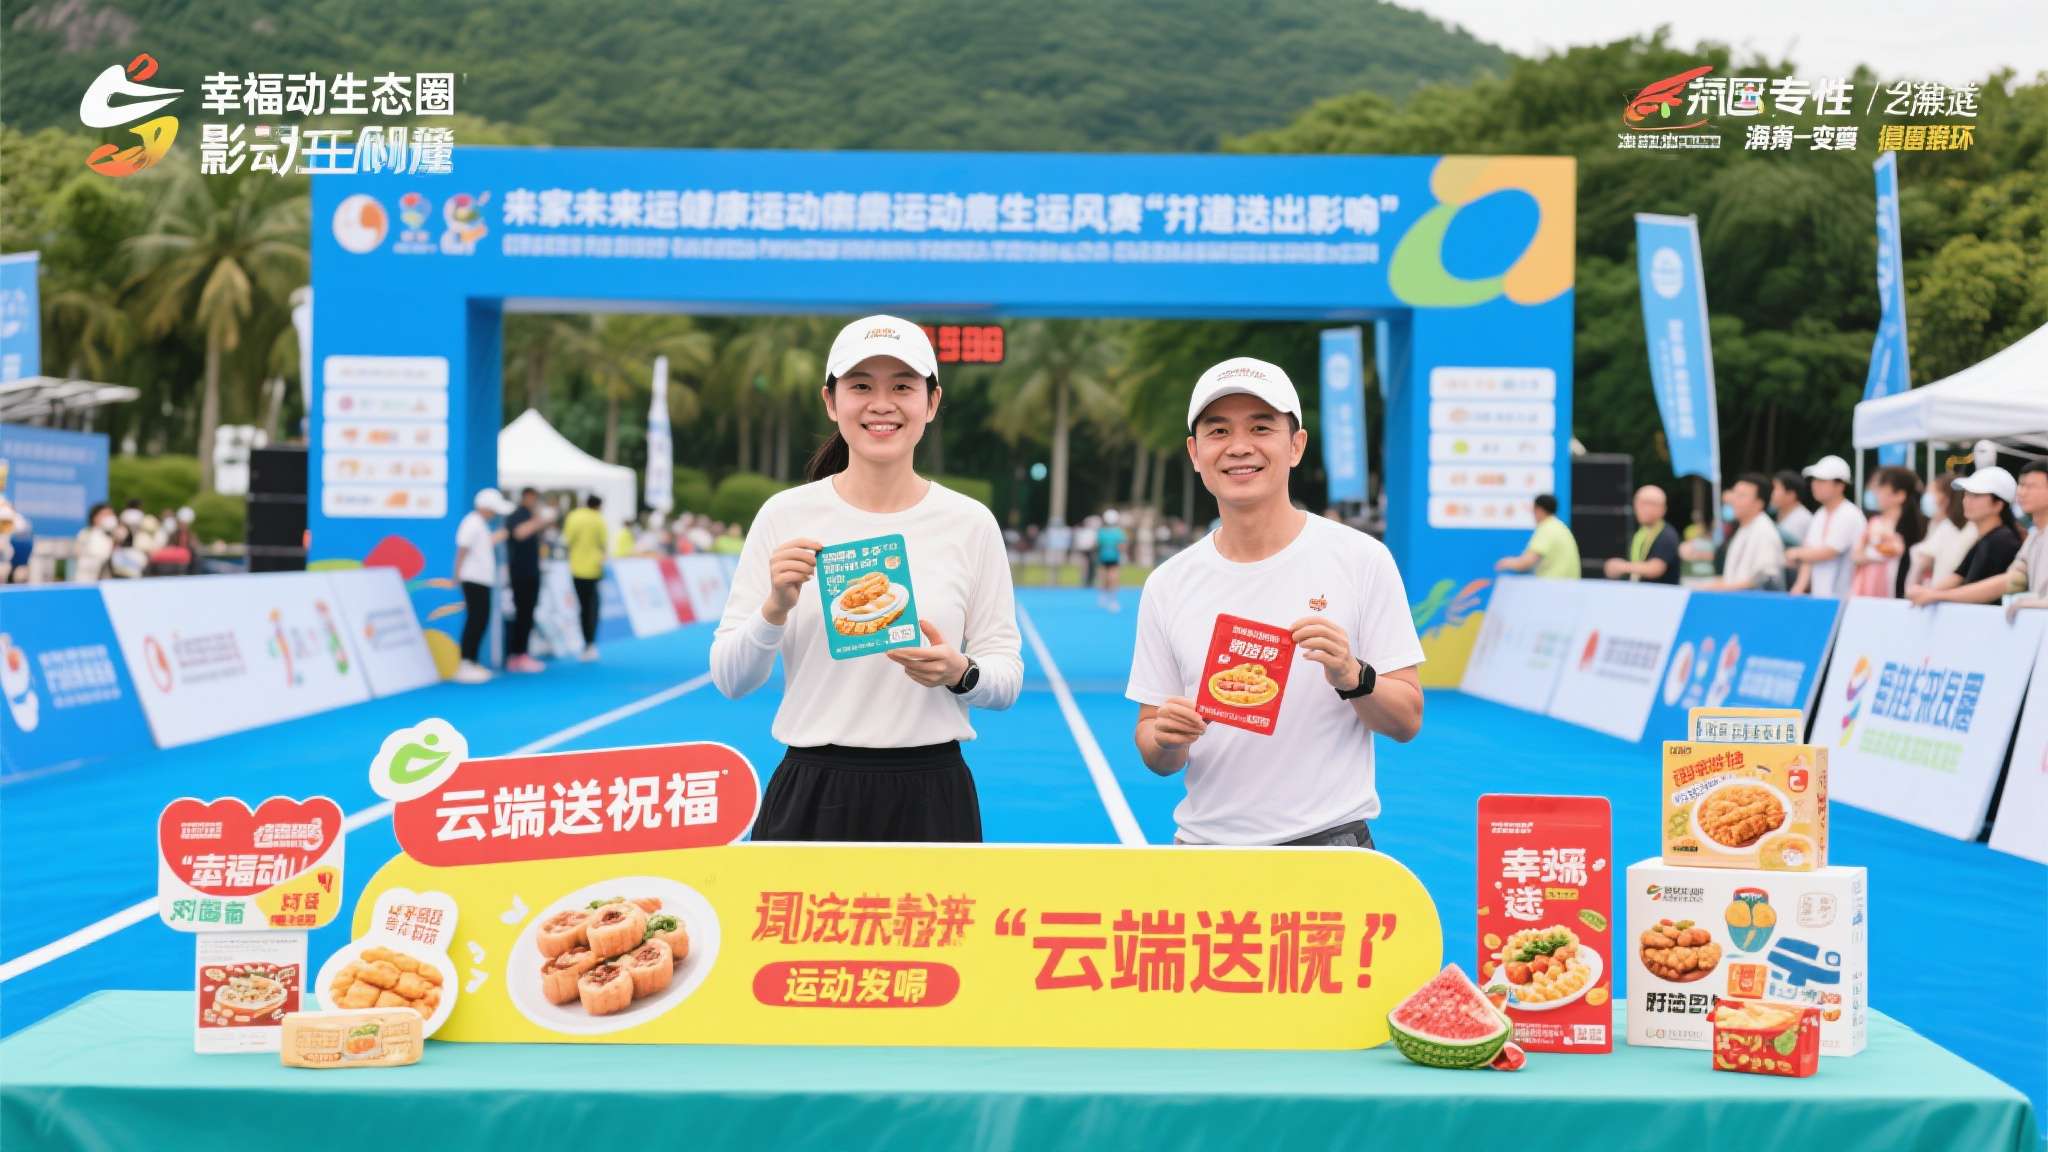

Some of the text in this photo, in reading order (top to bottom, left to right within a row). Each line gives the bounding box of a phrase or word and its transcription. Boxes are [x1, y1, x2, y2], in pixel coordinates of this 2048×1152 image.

[434, 769, 722, 843] 云端送祝福
